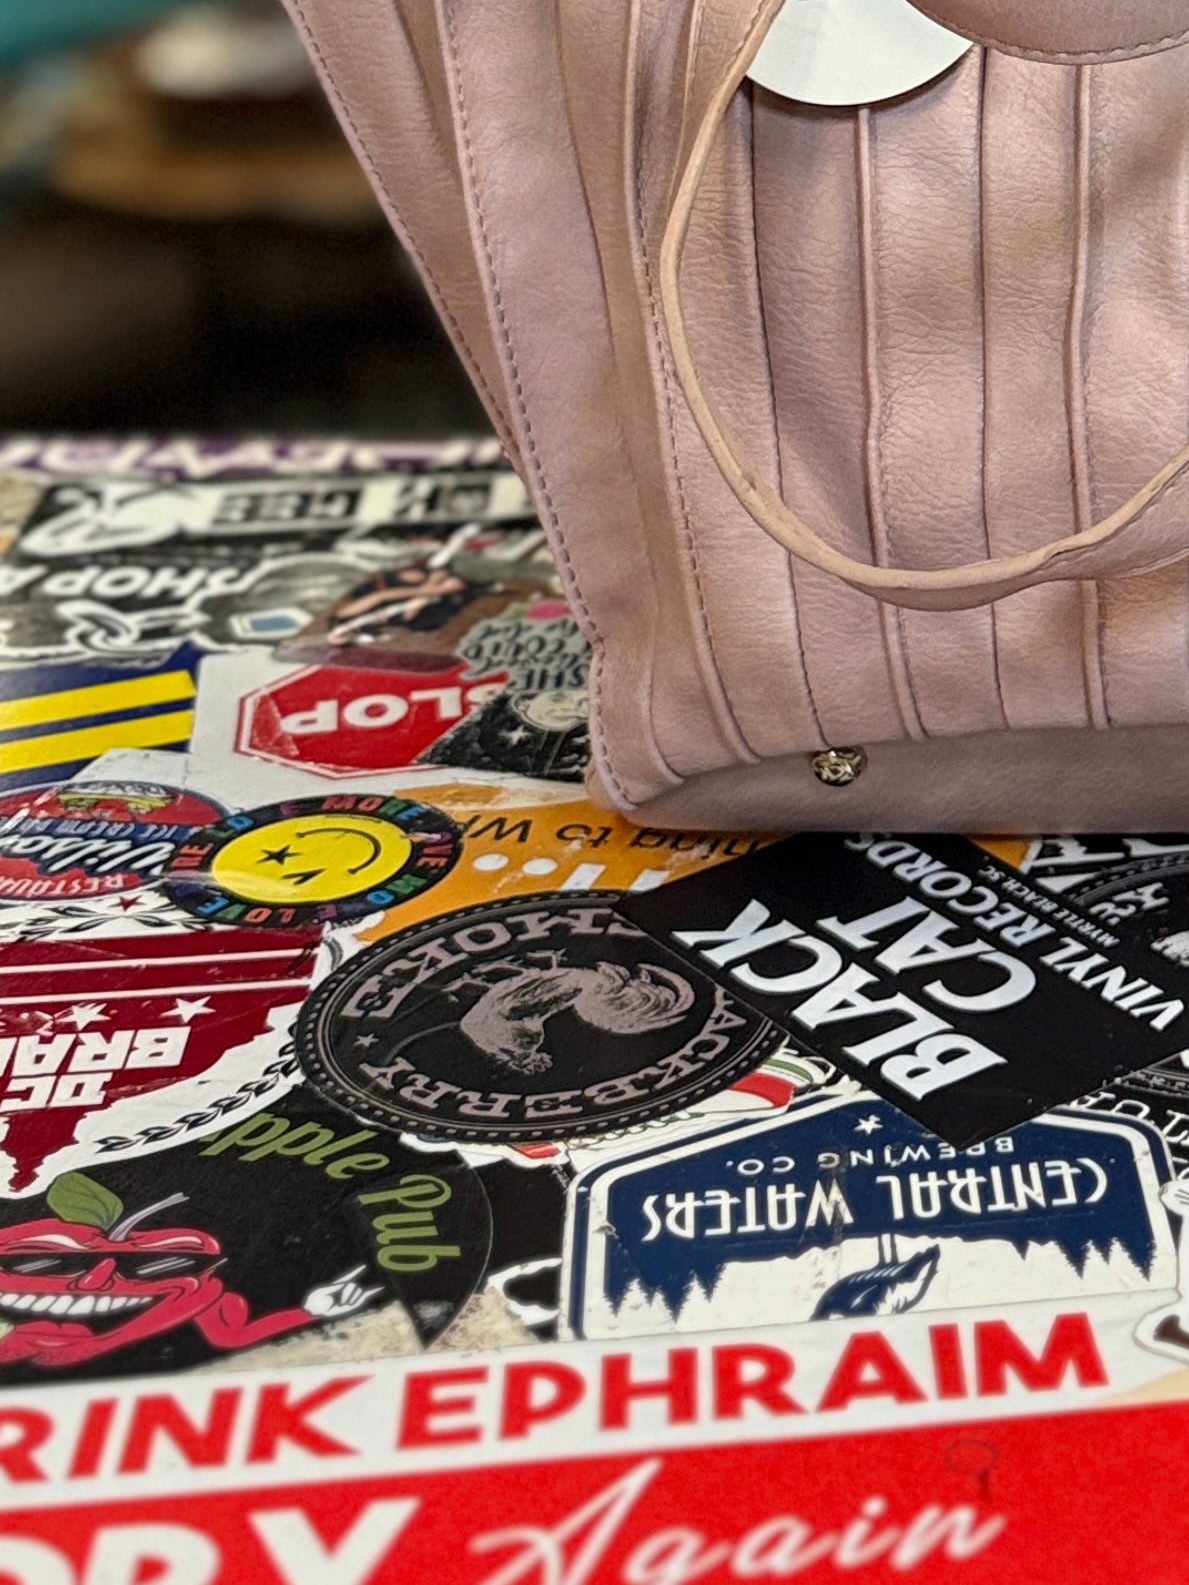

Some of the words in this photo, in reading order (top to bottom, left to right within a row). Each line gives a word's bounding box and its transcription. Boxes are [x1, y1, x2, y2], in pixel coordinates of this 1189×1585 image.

[555, 823, 613, 851] to
[844, 831, 1057, 948] RECORDS
[670, 897, 1009, 1102] BLACK
[815, 894, 1037, 1012] CAT
[1039, 936, 1188, 1031] VINYL
[640, 1174, 854, 1243] WATERS
[725, 1154, 797, 1176] CO.
[875, 1157, 1108, 1221] CENTRAL
[357, 1173, 462, 1274] Pub
[396, 1312, 1110, 1451] EPHRAIM
